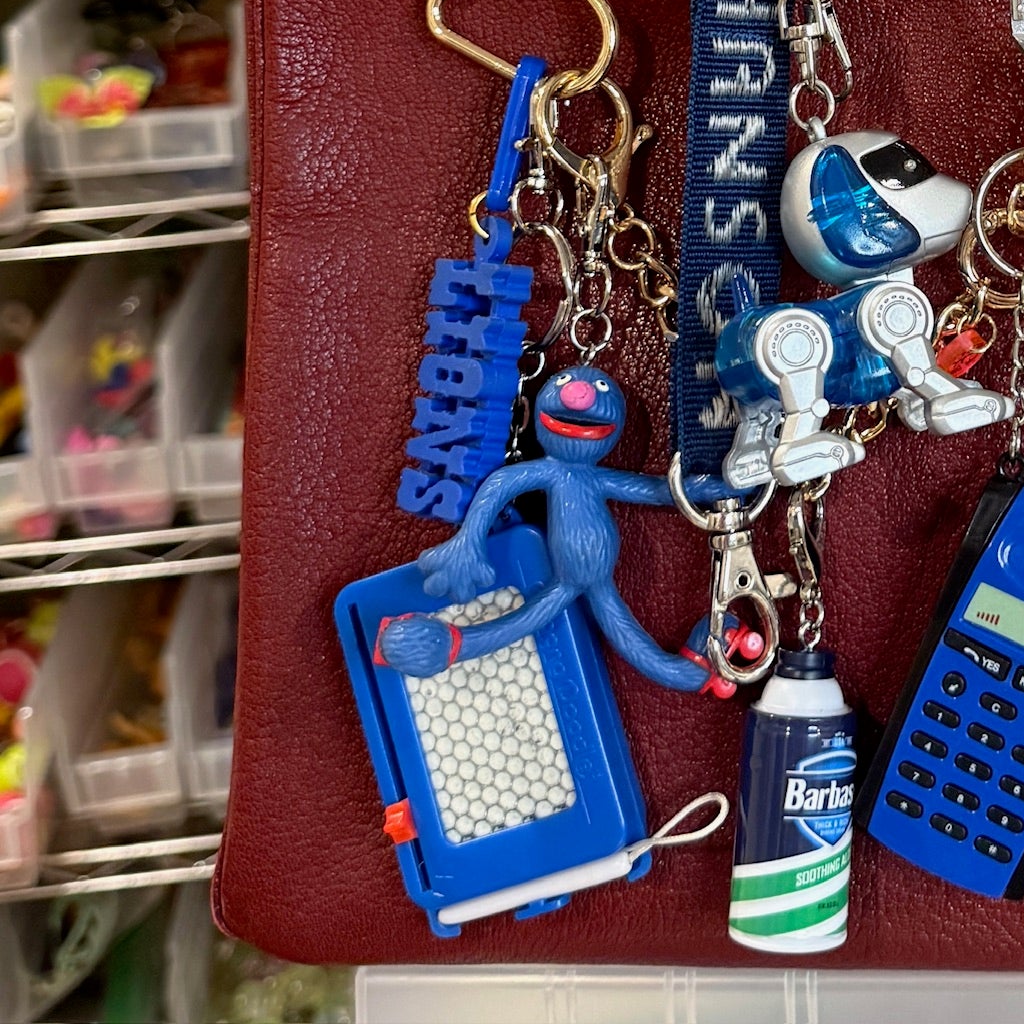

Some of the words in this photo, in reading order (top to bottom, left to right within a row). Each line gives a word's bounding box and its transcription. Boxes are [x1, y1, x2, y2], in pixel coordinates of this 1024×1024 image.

[396, 259, 502, 521] LIONS
[982, 656, 1000, 673] YES
[991, 703, 1001, 713] C
[795, 857, 840, 887] SOOTHING
